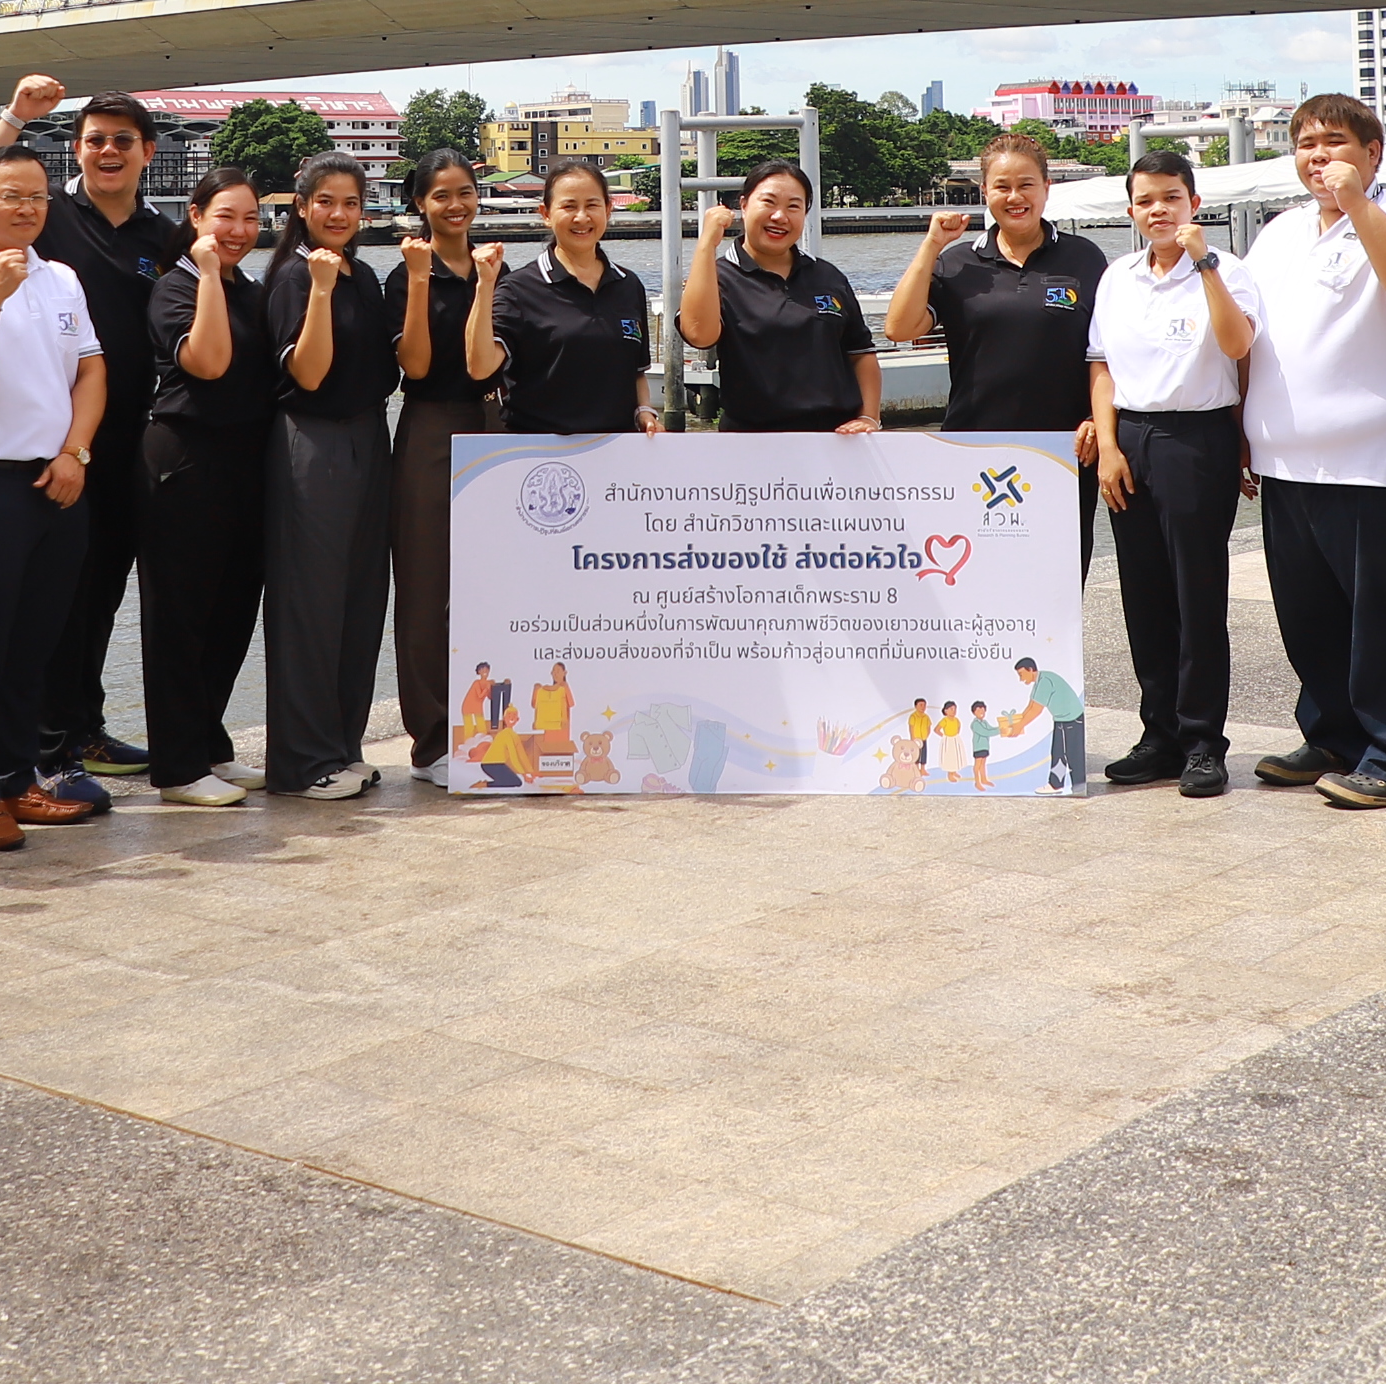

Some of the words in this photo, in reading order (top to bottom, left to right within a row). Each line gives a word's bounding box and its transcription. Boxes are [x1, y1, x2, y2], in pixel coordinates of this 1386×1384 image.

[814, 295, 835, 311] 51
[1045, 287, 1067, 303] 51
[58, 312, 74, 331] 51
[1166, 318, 1186, 337] 51
[605, 477, 955, 507] สำนักงานการปฏิรูปที่ดินเพื่อเกษตรกรรม
[645, 512, 677, 532] โดย
[683, 513, 905, 533] สำนักวิชาการและแผนงาน
[572, 543, 788, 570] โครงการส่งของใช้
[795, 543, 923, 570] ส่งต่อหัวใจ
[633, 589, 650, 604] ณ
[657, 585, 881, 609] ศูนย์สร้างโอกาสเด็กพระราม
[887, 587, 898, 604] 8
[509, 610, 1036, 637] ขอร่วมเป็นส่วนหนึ่งในการพัฒนาคุณภาพชีวิตของเยาวชนและผู้สูงอายุ
[533, 638, 731, 661] และส่งมอบสิ่งของที่จำเป็น
[737, 638, 1012, 664] พร้อมก้าวสู่อนาคตที่มั่นคงและยั่งยืน
